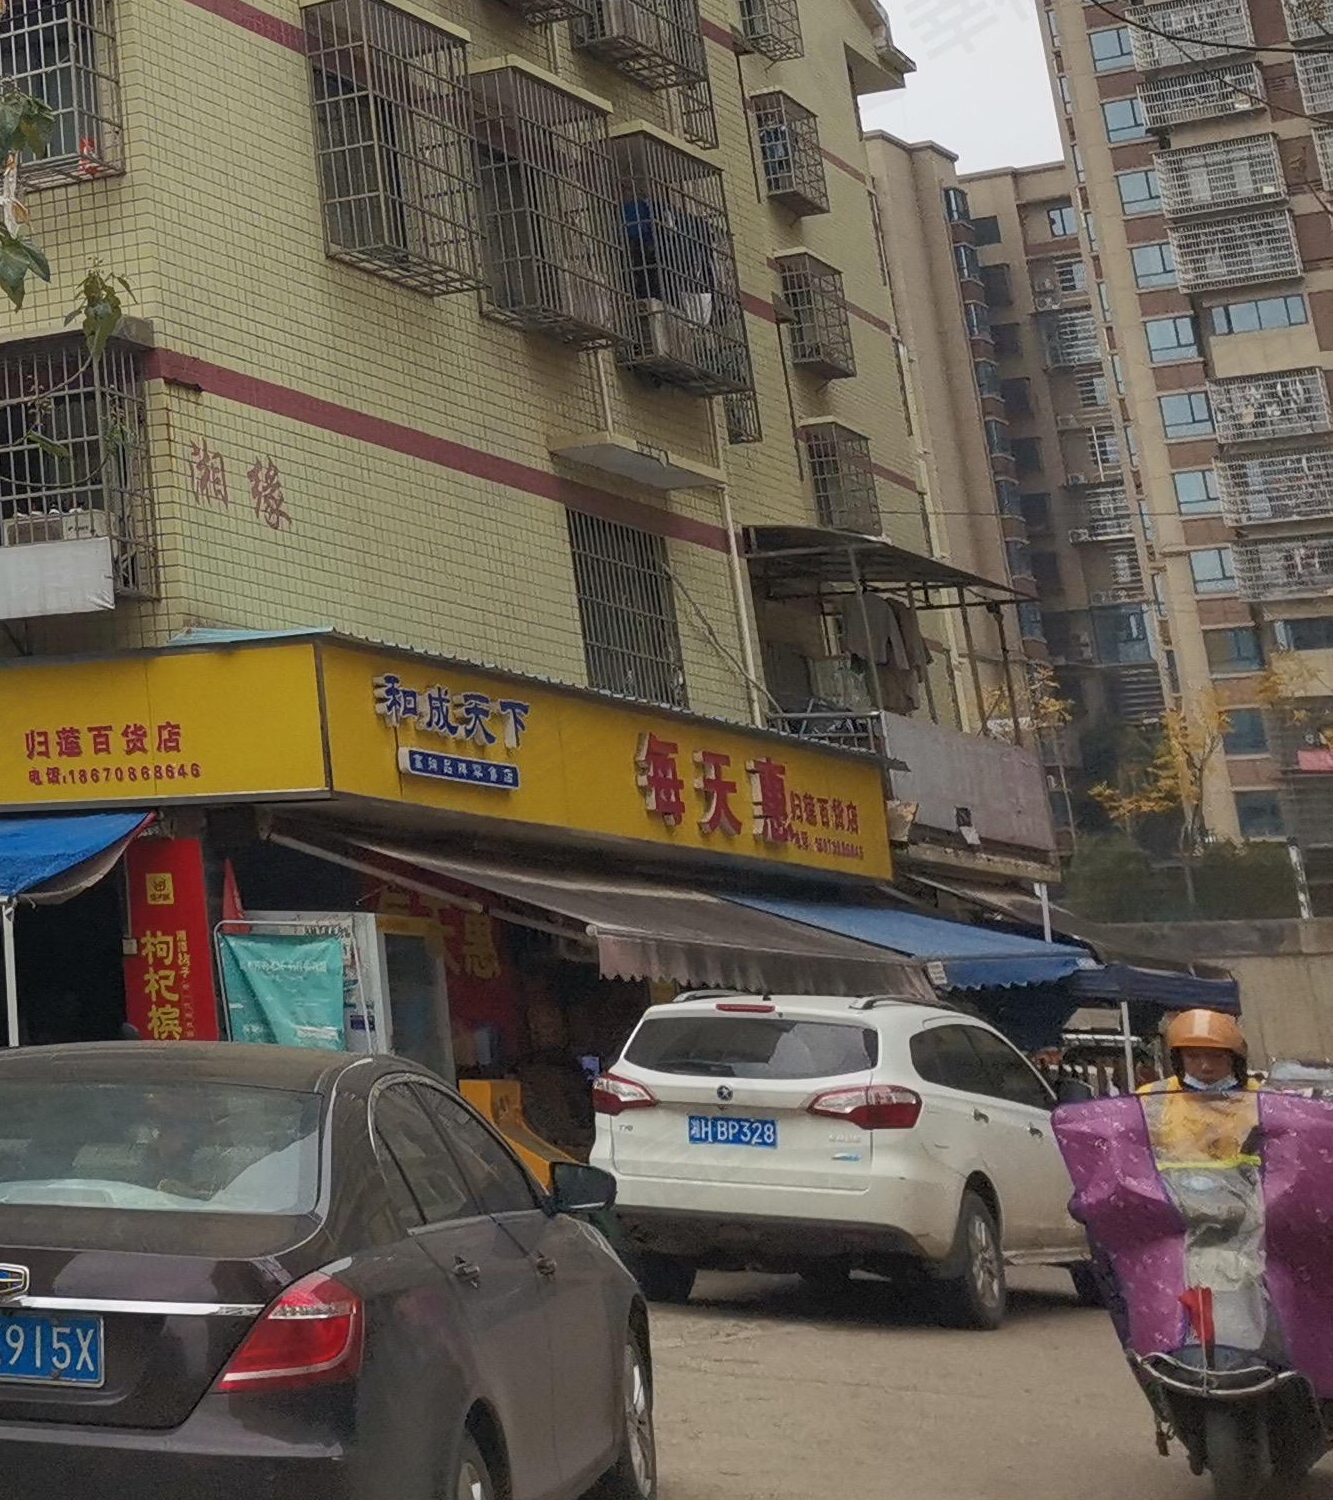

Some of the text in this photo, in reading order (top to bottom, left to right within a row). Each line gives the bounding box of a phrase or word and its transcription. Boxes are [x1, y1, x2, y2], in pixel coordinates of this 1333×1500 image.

[25, 721, 182, 760] 归莲百货店
[379, 673, 531, 750] 和成天下
[637, 731, 789, 843] 每天惠
